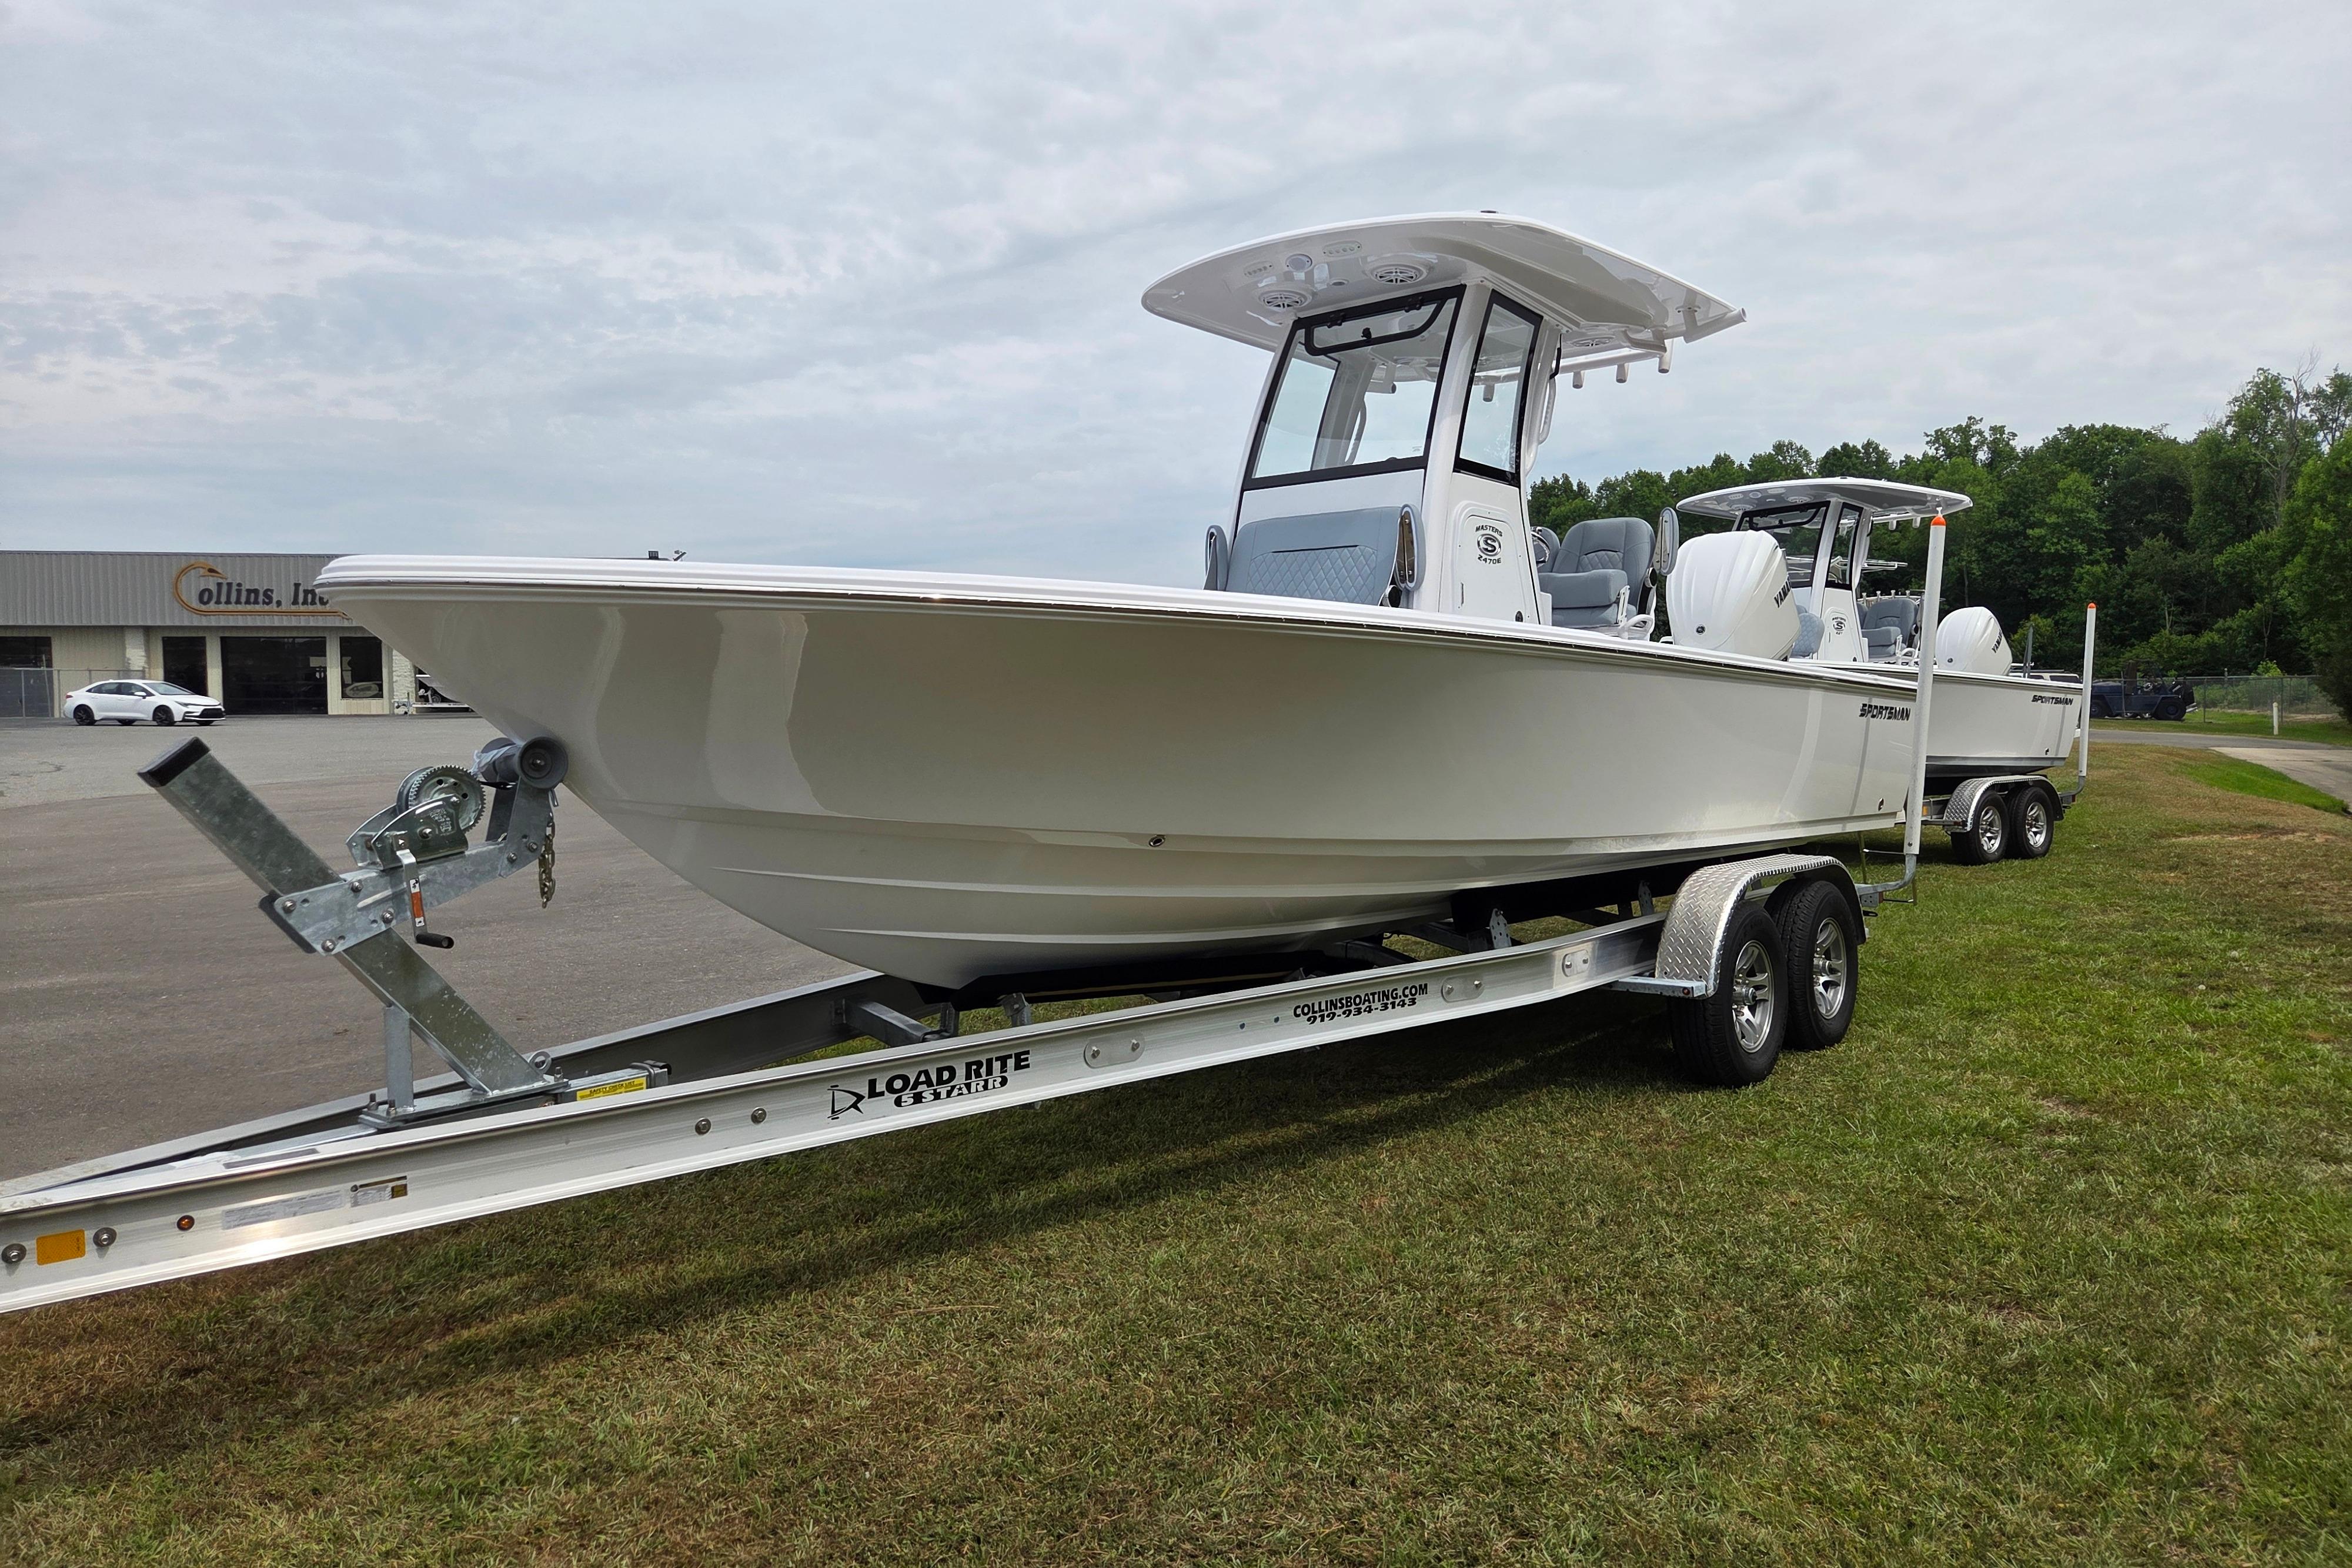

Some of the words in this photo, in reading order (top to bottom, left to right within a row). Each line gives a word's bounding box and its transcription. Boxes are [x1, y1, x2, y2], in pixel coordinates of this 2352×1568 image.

[1475, 524, 1503, 537] MASTERS
[1482, 536, 1496, 553] S
[1774, 580, 1790, 609] YAMA
[1859, 703, 1910, 721] SPORTSMAN
[2032, 694, 2073, 706] SPORTSMAN
[1293, 983, 1428, 1018] COLLINSBOATING.COM
[1306, 997, 1417, 1025] 919-934-3143
[867, 1065, 957, 1099] LOAD
[965, 1050, 1030, 1081] RITE
[901, 1094, 915, 1106] 5
[921, 1076, 1002, 1104] STARR
